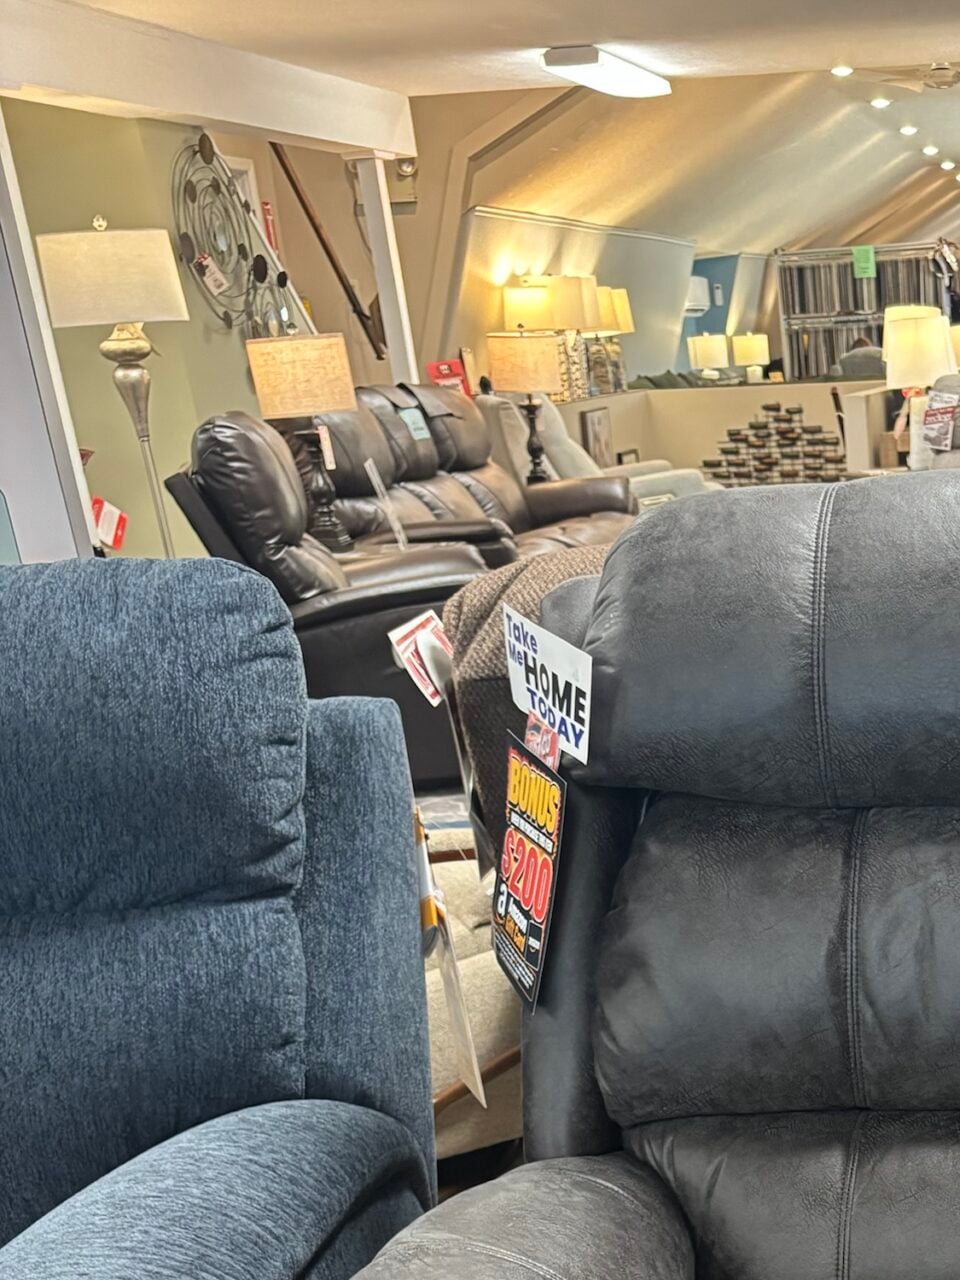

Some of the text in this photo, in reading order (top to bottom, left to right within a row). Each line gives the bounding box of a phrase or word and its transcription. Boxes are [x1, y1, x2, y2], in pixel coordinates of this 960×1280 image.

[506, 612, 538, 655] Take
[508, 639, 523, 667] Me
[524, 652, 587, 728] HOME
[526, 686, 585, 749] TODAY
[508, 756, 559, 835] BONUS
[501, 828, 554, 923] $200
